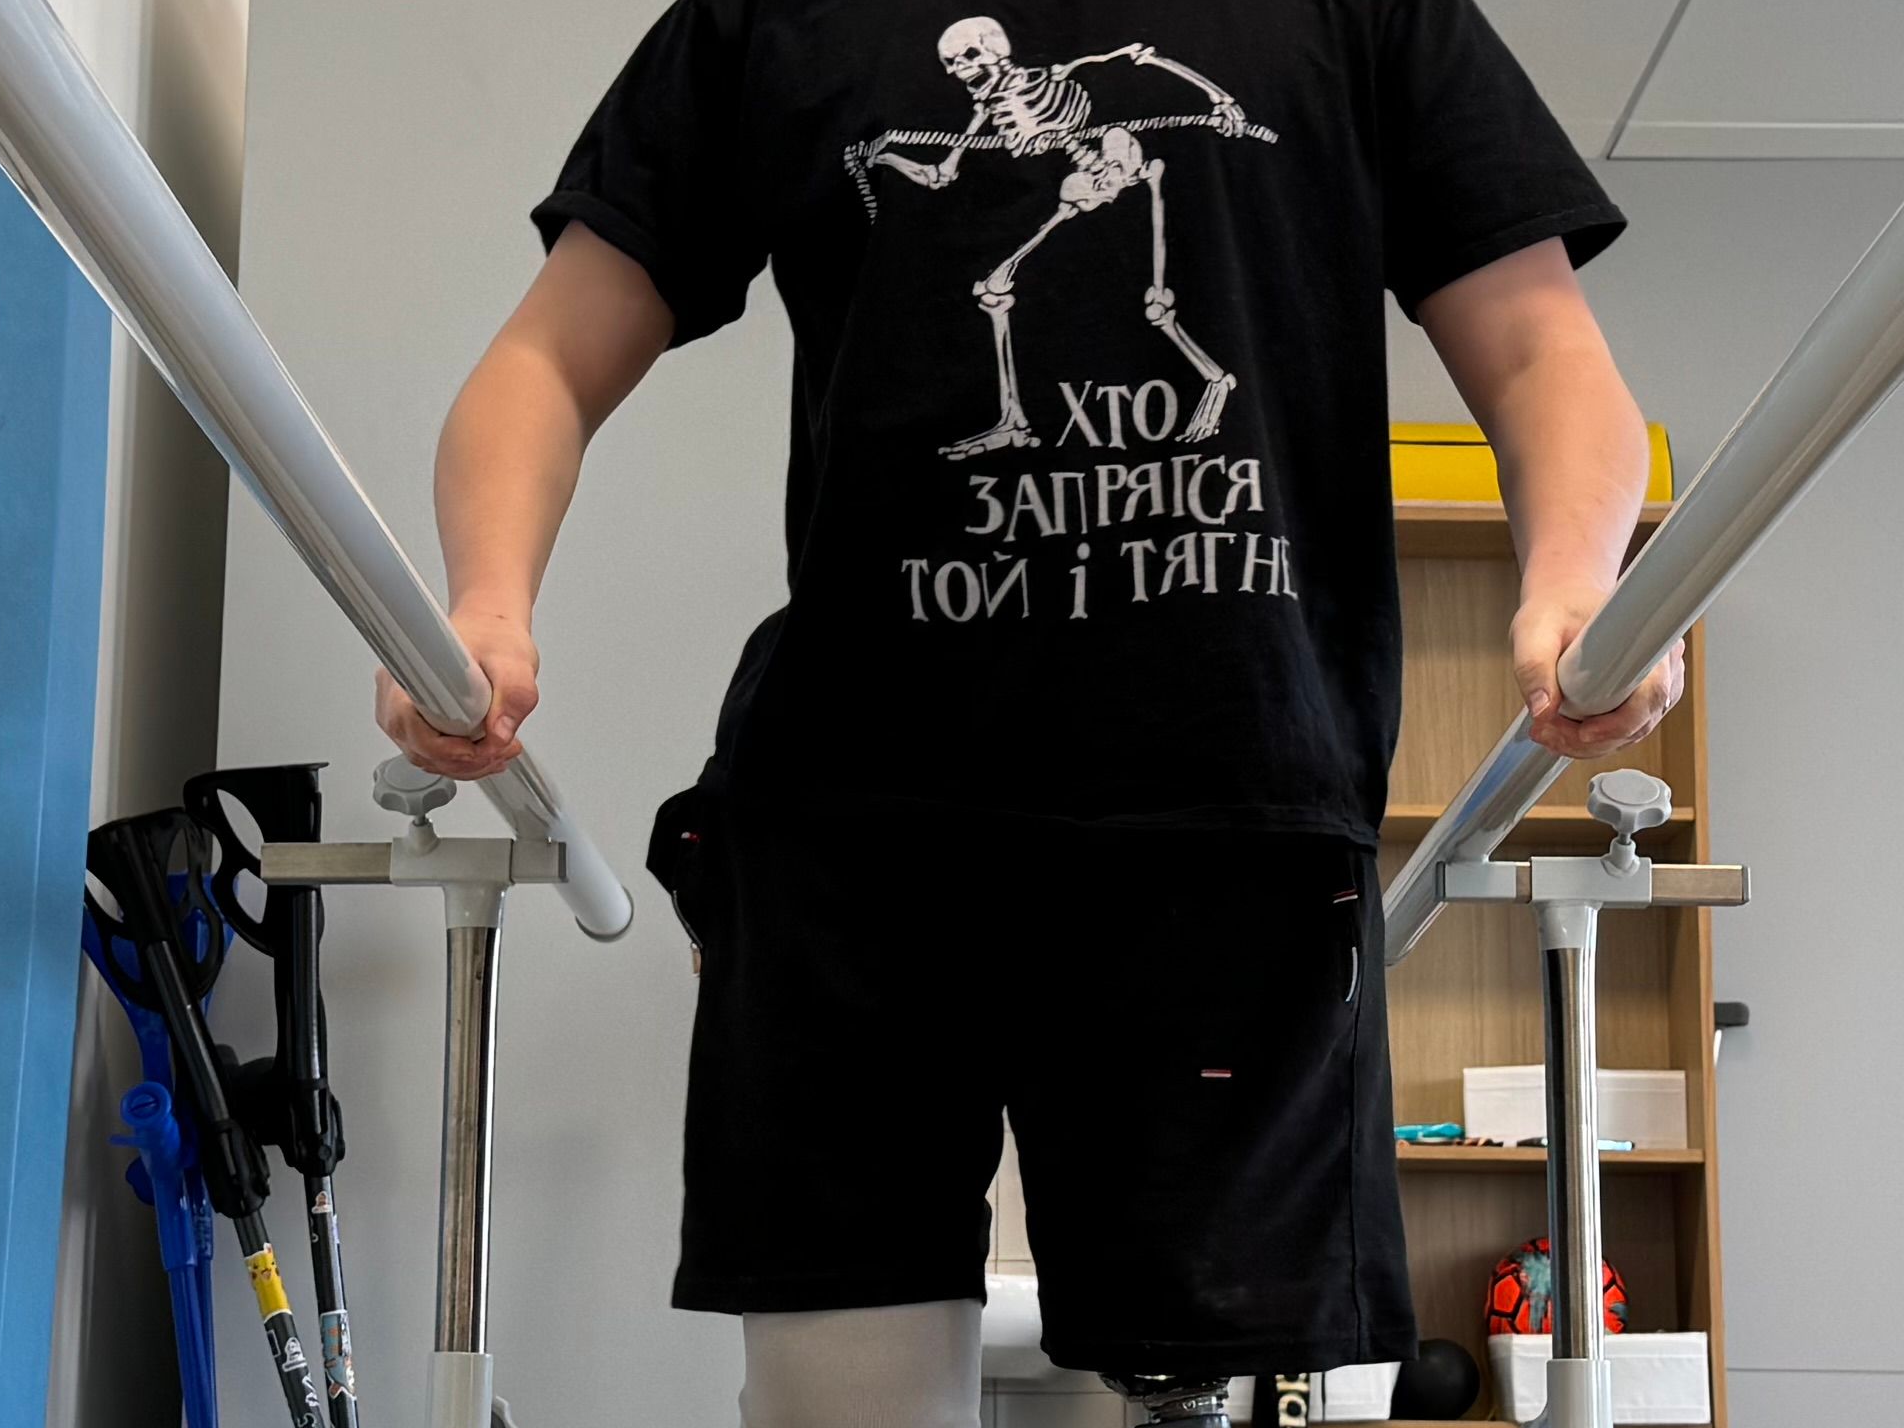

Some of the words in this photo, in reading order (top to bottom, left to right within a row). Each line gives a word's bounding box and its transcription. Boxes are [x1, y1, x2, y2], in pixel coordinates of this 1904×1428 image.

[1056, 379, 1178, 450] ХТО
[965, 454, 1264, 542] ЗАПРЯГСЯ
[901, 551, 1030, 622] ТОЙ
